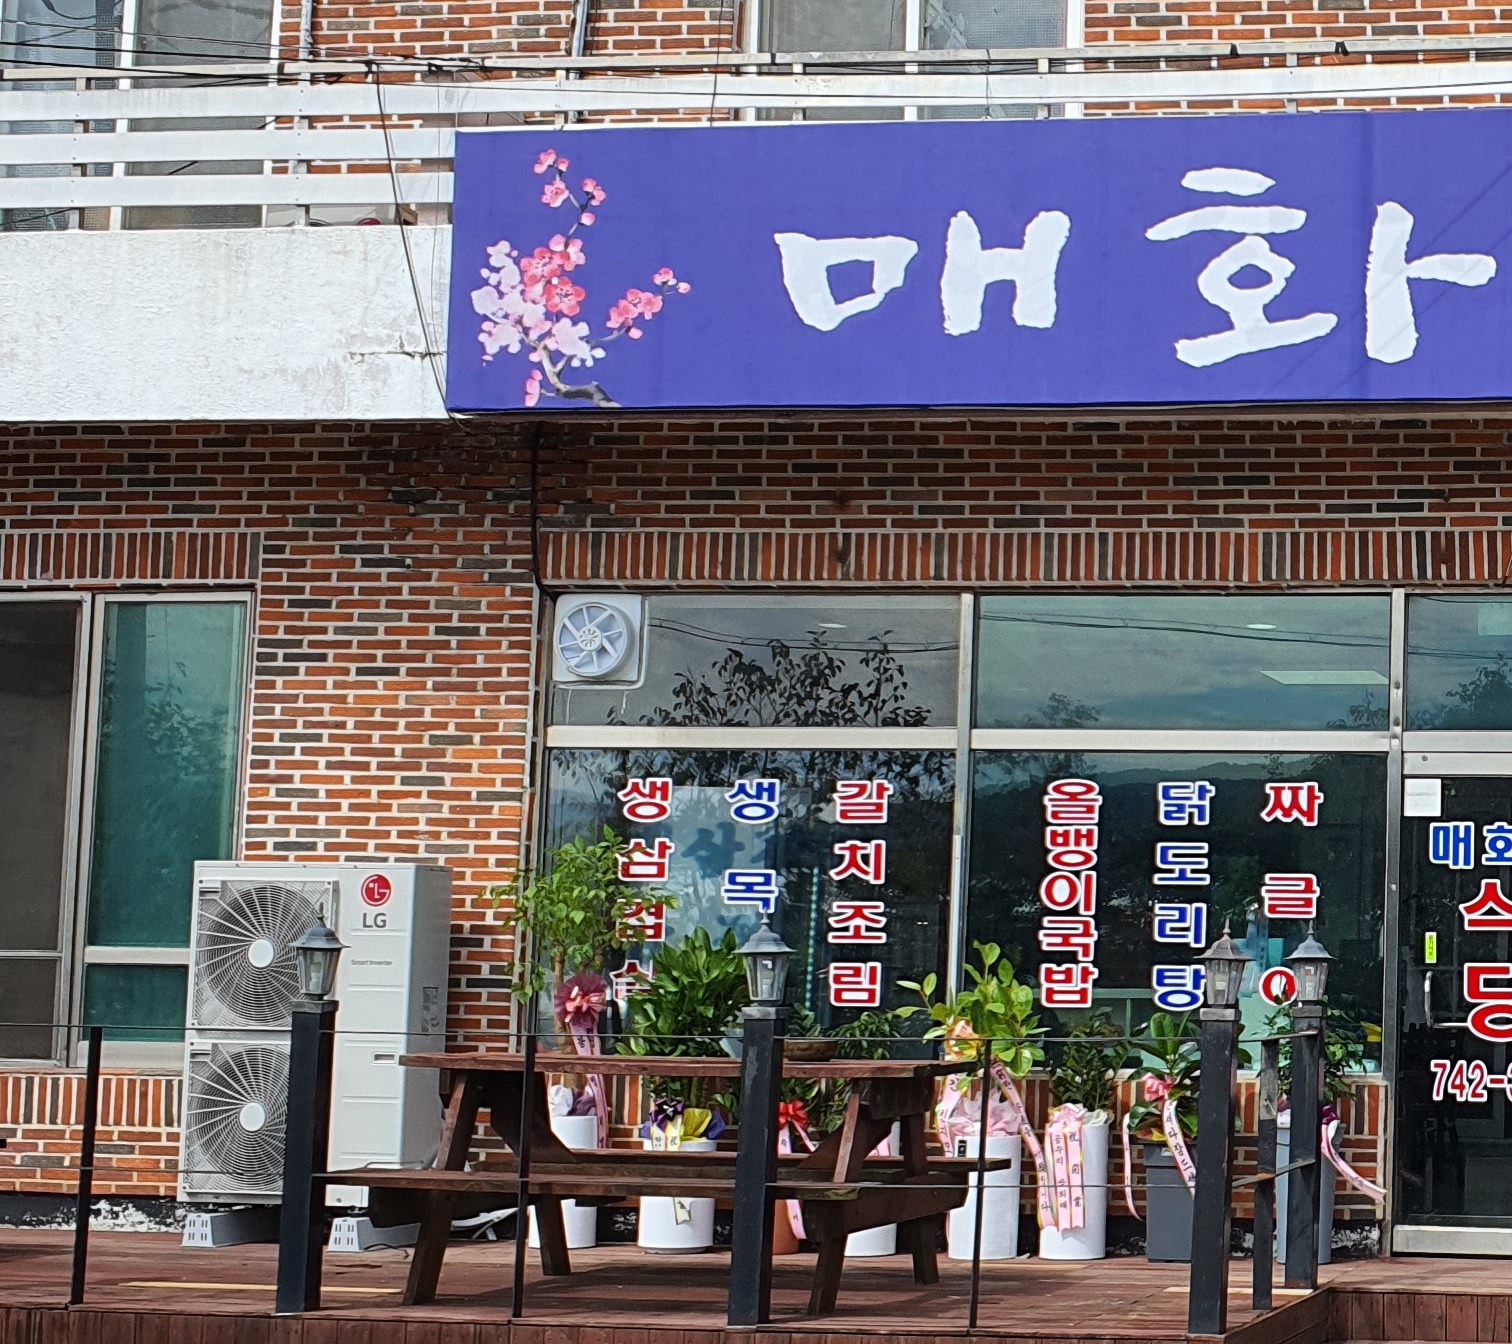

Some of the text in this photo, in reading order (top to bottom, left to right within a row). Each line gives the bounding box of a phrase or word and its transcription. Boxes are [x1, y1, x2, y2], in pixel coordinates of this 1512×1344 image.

[362, 912, 387, 928] LG
[827, 779, 893, 1007] 갈치조림
[1038, 778, 1102, 1008] 올뱅이국밥
[1152, 780, 1215, 1011] 닭도리탕
